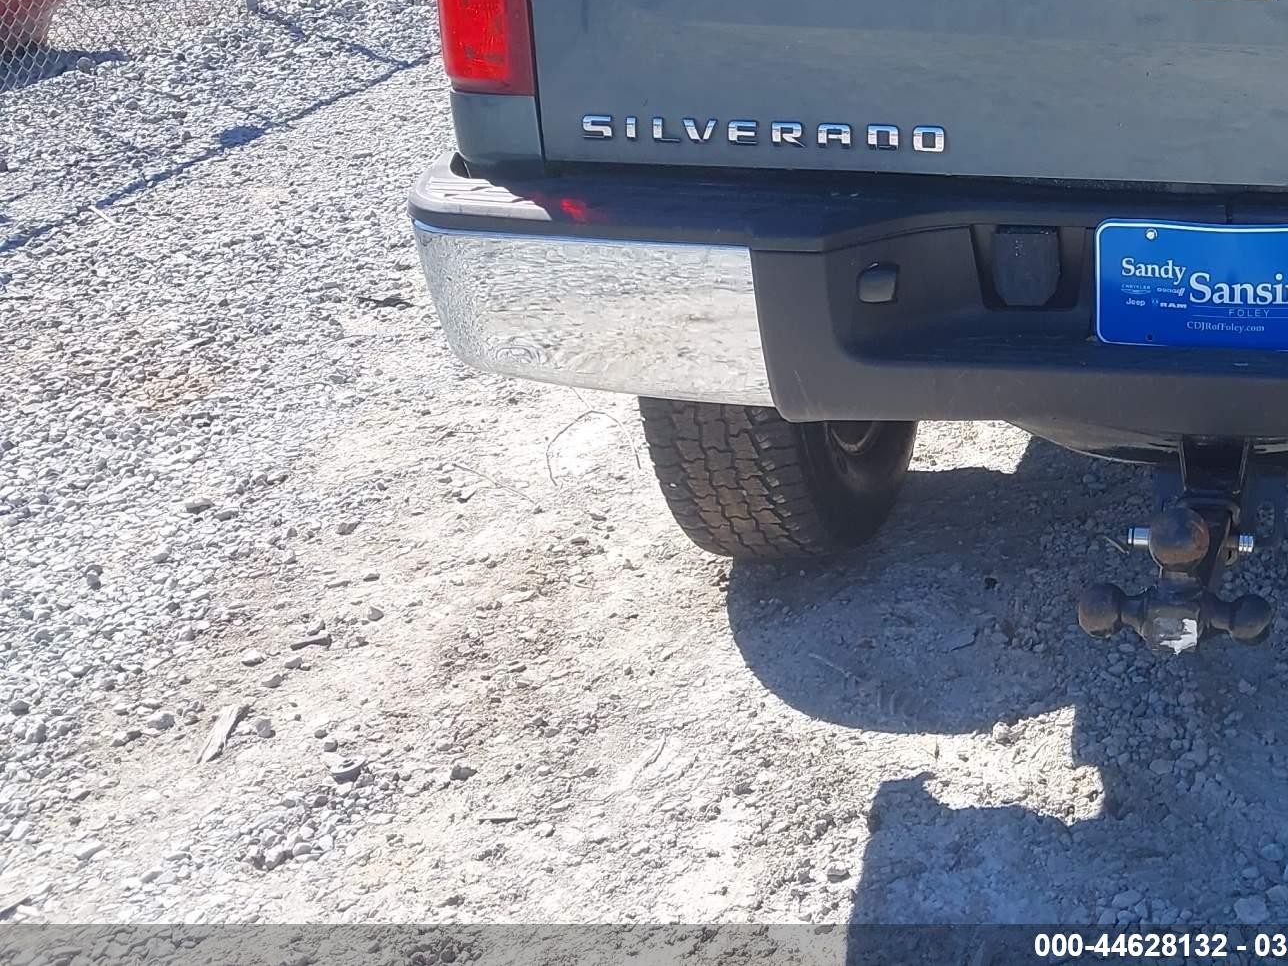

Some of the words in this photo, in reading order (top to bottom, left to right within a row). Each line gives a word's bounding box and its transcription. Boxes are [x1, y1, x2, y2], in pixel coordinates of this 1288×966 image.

[582, 114, 946, 153] SILVERADO
[1121, 256, 1187, 285] Sandy
[1126, 298, 1146, 307] Jeep
[1229, 309, 1270, 317] FOLEY
[1186, 320, 1265, 333] CDJRofFoley.com
